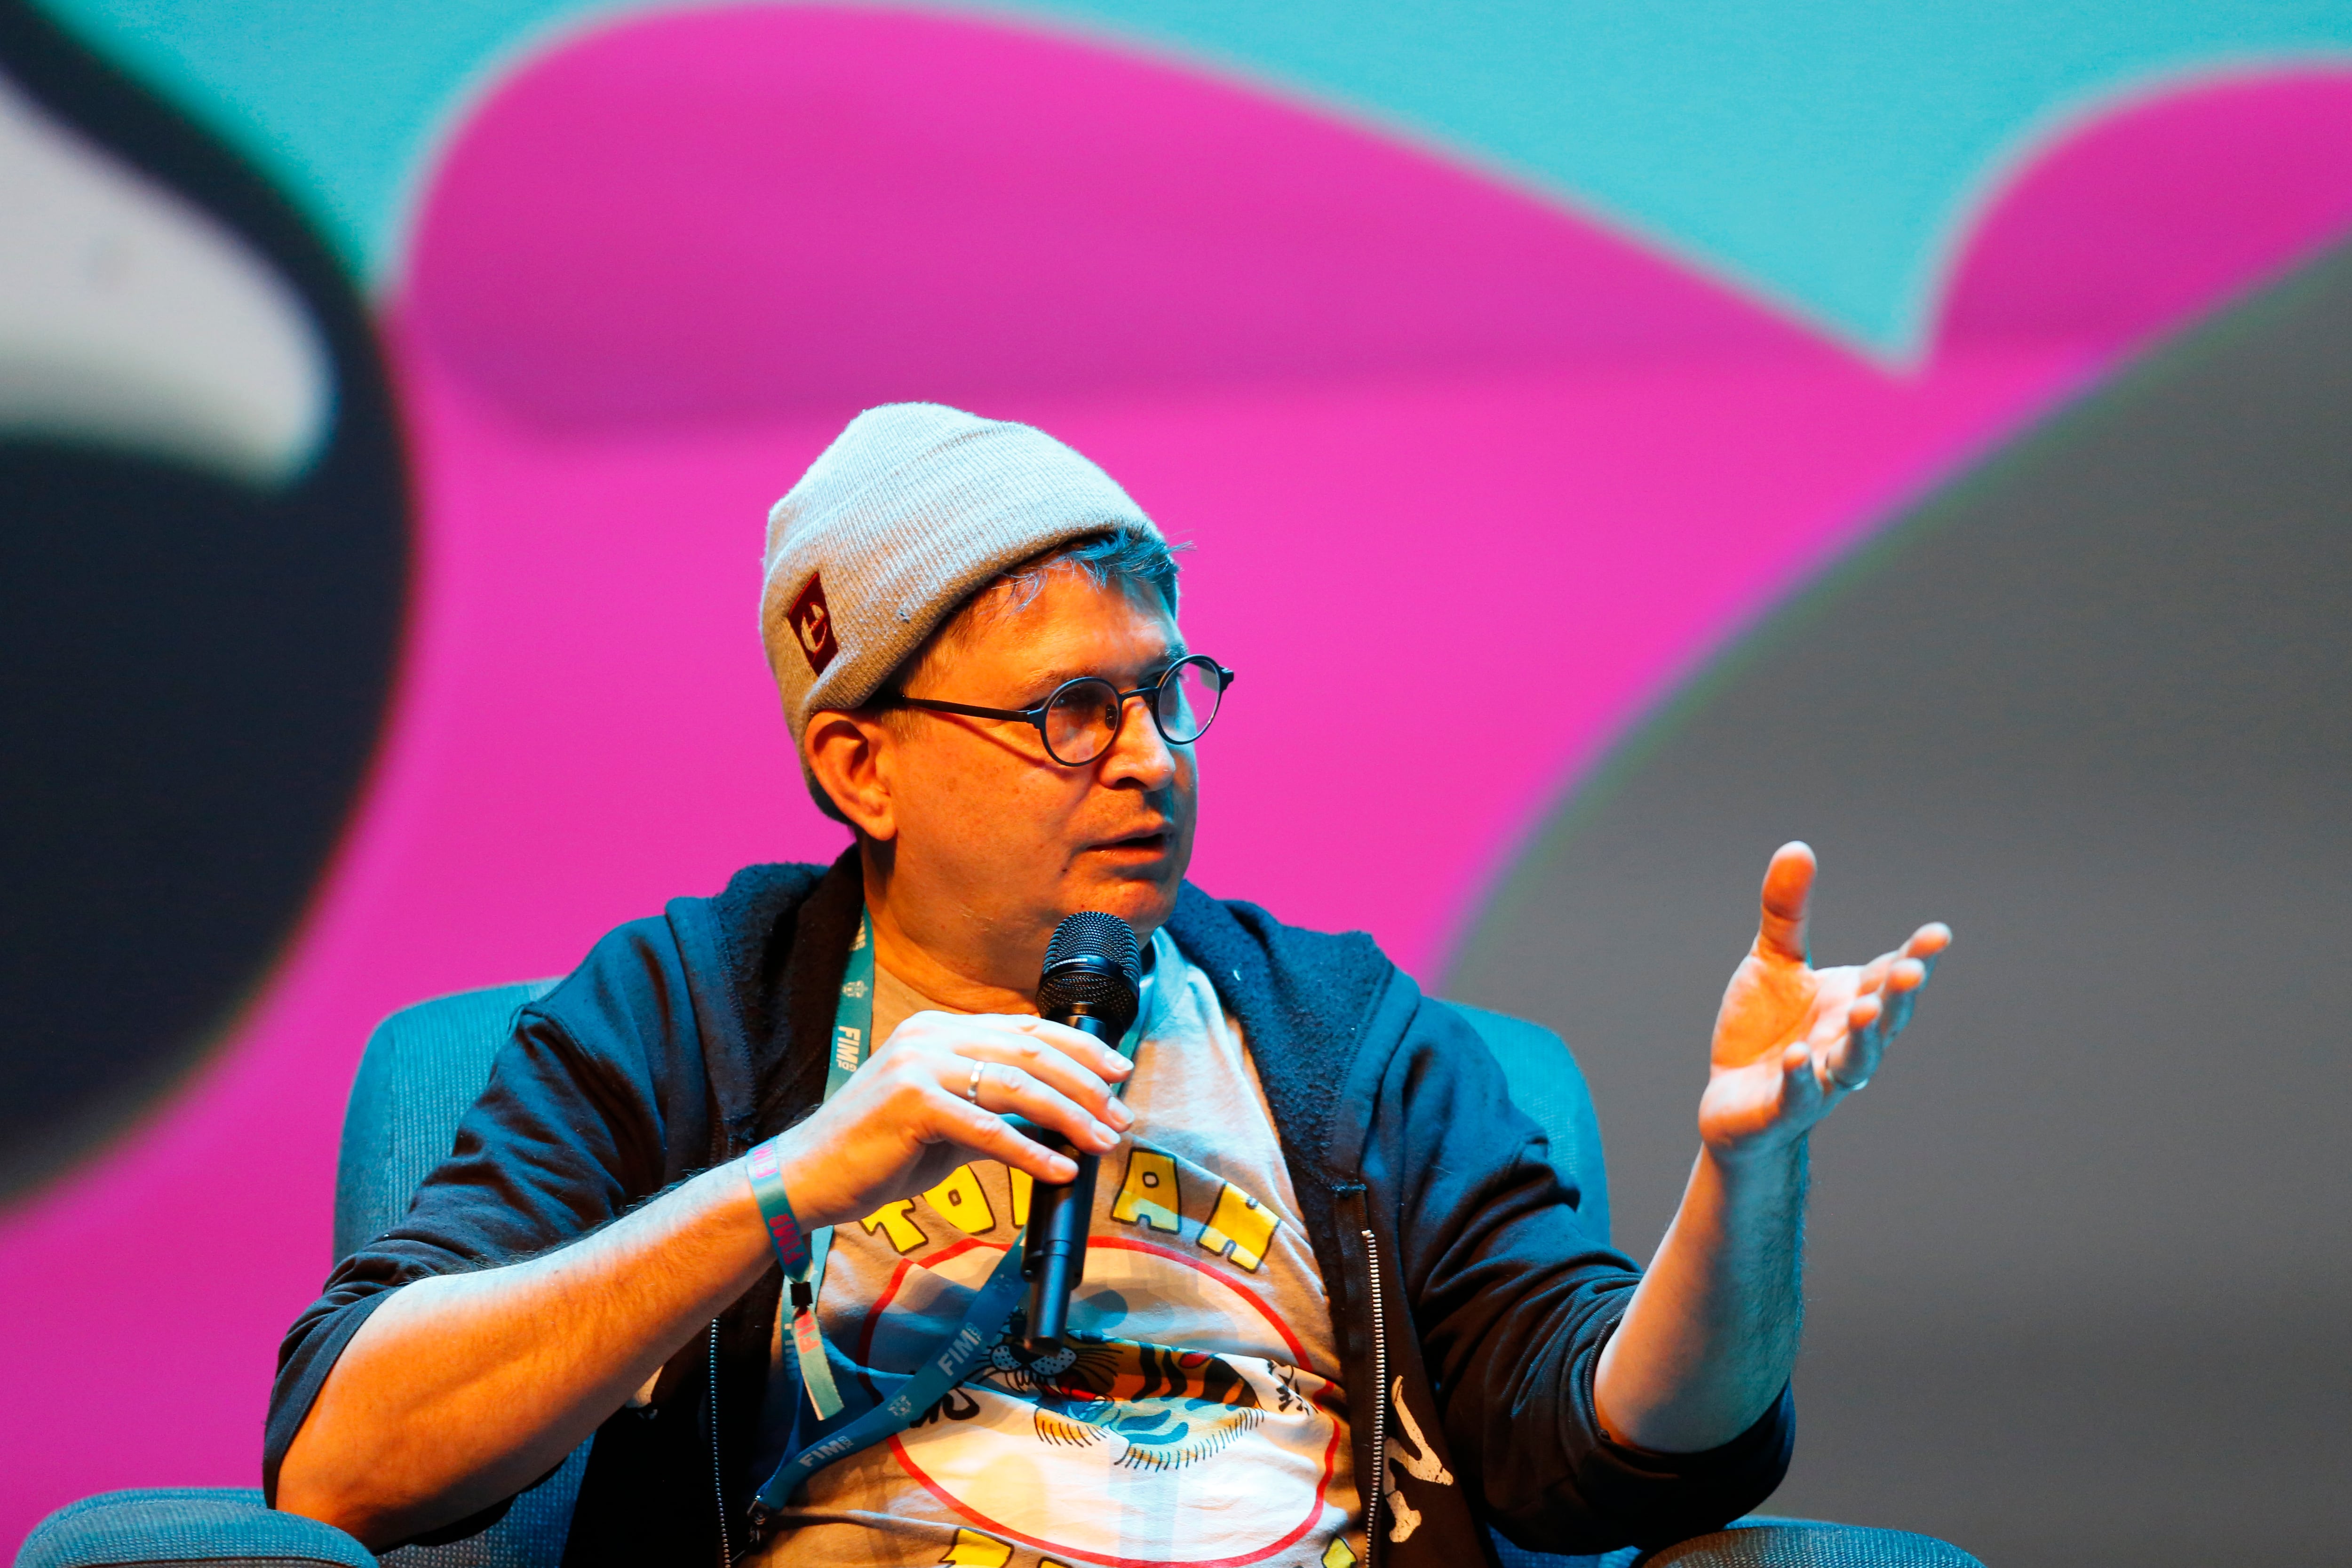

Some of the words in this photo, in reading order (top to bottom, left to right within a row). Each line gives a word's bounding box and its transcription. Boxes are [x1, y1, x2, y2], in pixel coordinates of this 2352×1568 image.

[836, 1026, 861, 1064] FIM
[773, 1223, 804, 1266] FIM
[938, 1329, 979, 1376] FIM
[798, 1441, 846, 1467] FIM
